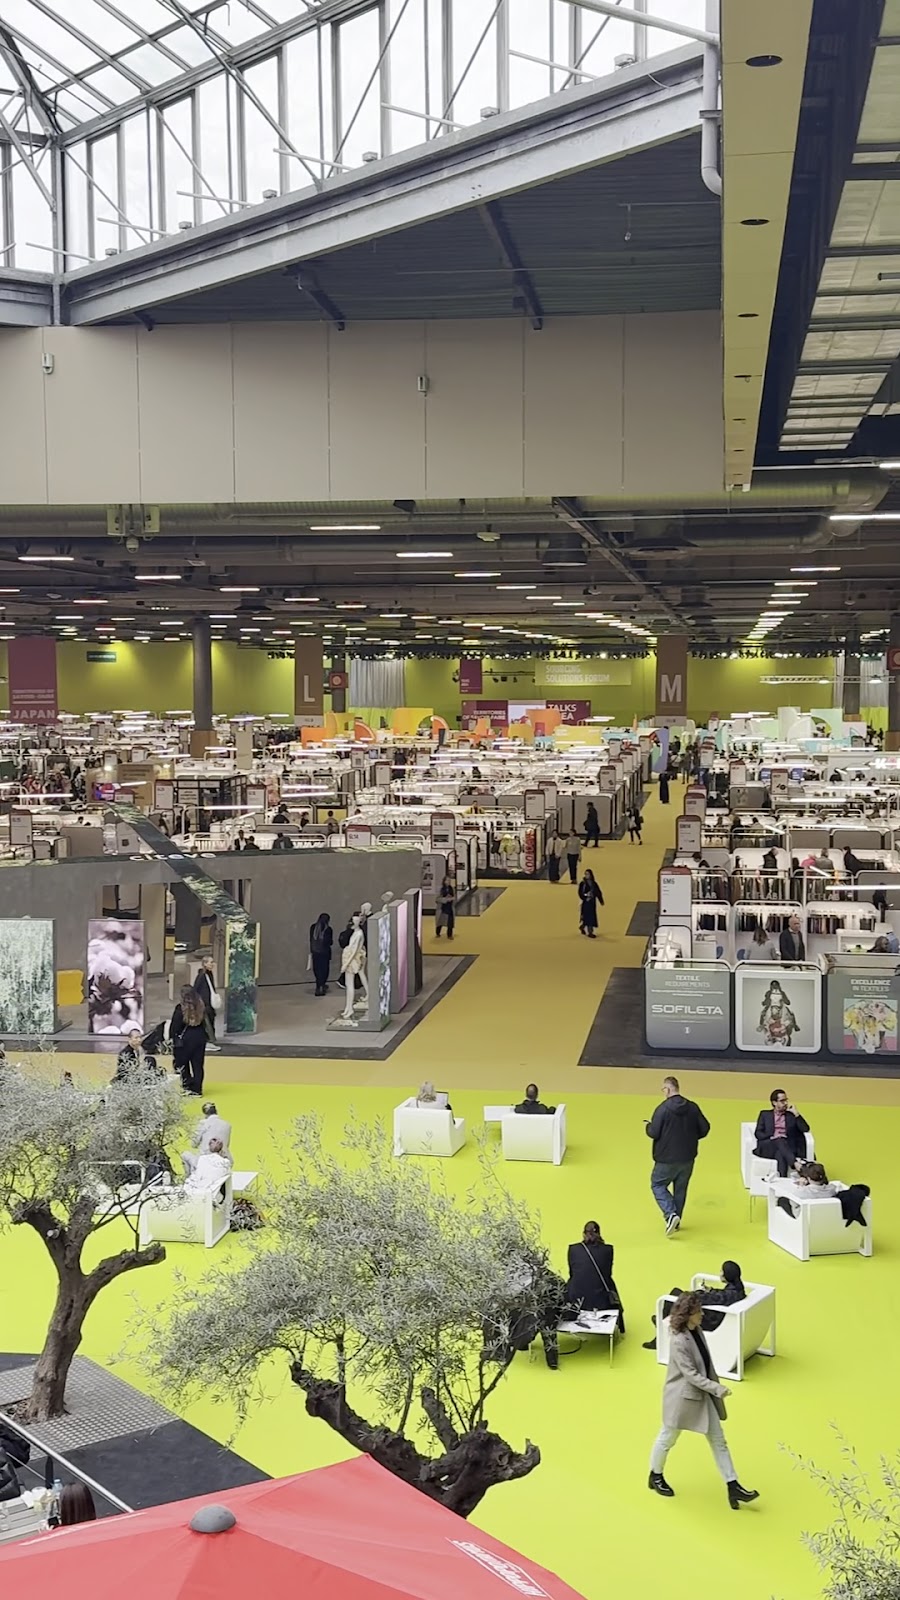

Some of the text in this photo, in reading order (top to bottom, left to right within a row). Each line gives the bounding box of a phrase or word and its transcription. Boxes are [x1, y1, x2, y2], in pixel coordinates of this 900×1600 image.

[546, 664, 580, 673] SOURCING
[546, 674, 610, 683] SOLUTIONS FORUM
[304, 675, 315, 702] L
[661, 675, 681, 702] M
[549, 704, 577, 712] TALKS
[13, 709, 56, 719] JAPAN
[651, 1004, 724, 1015] SOFILETA
